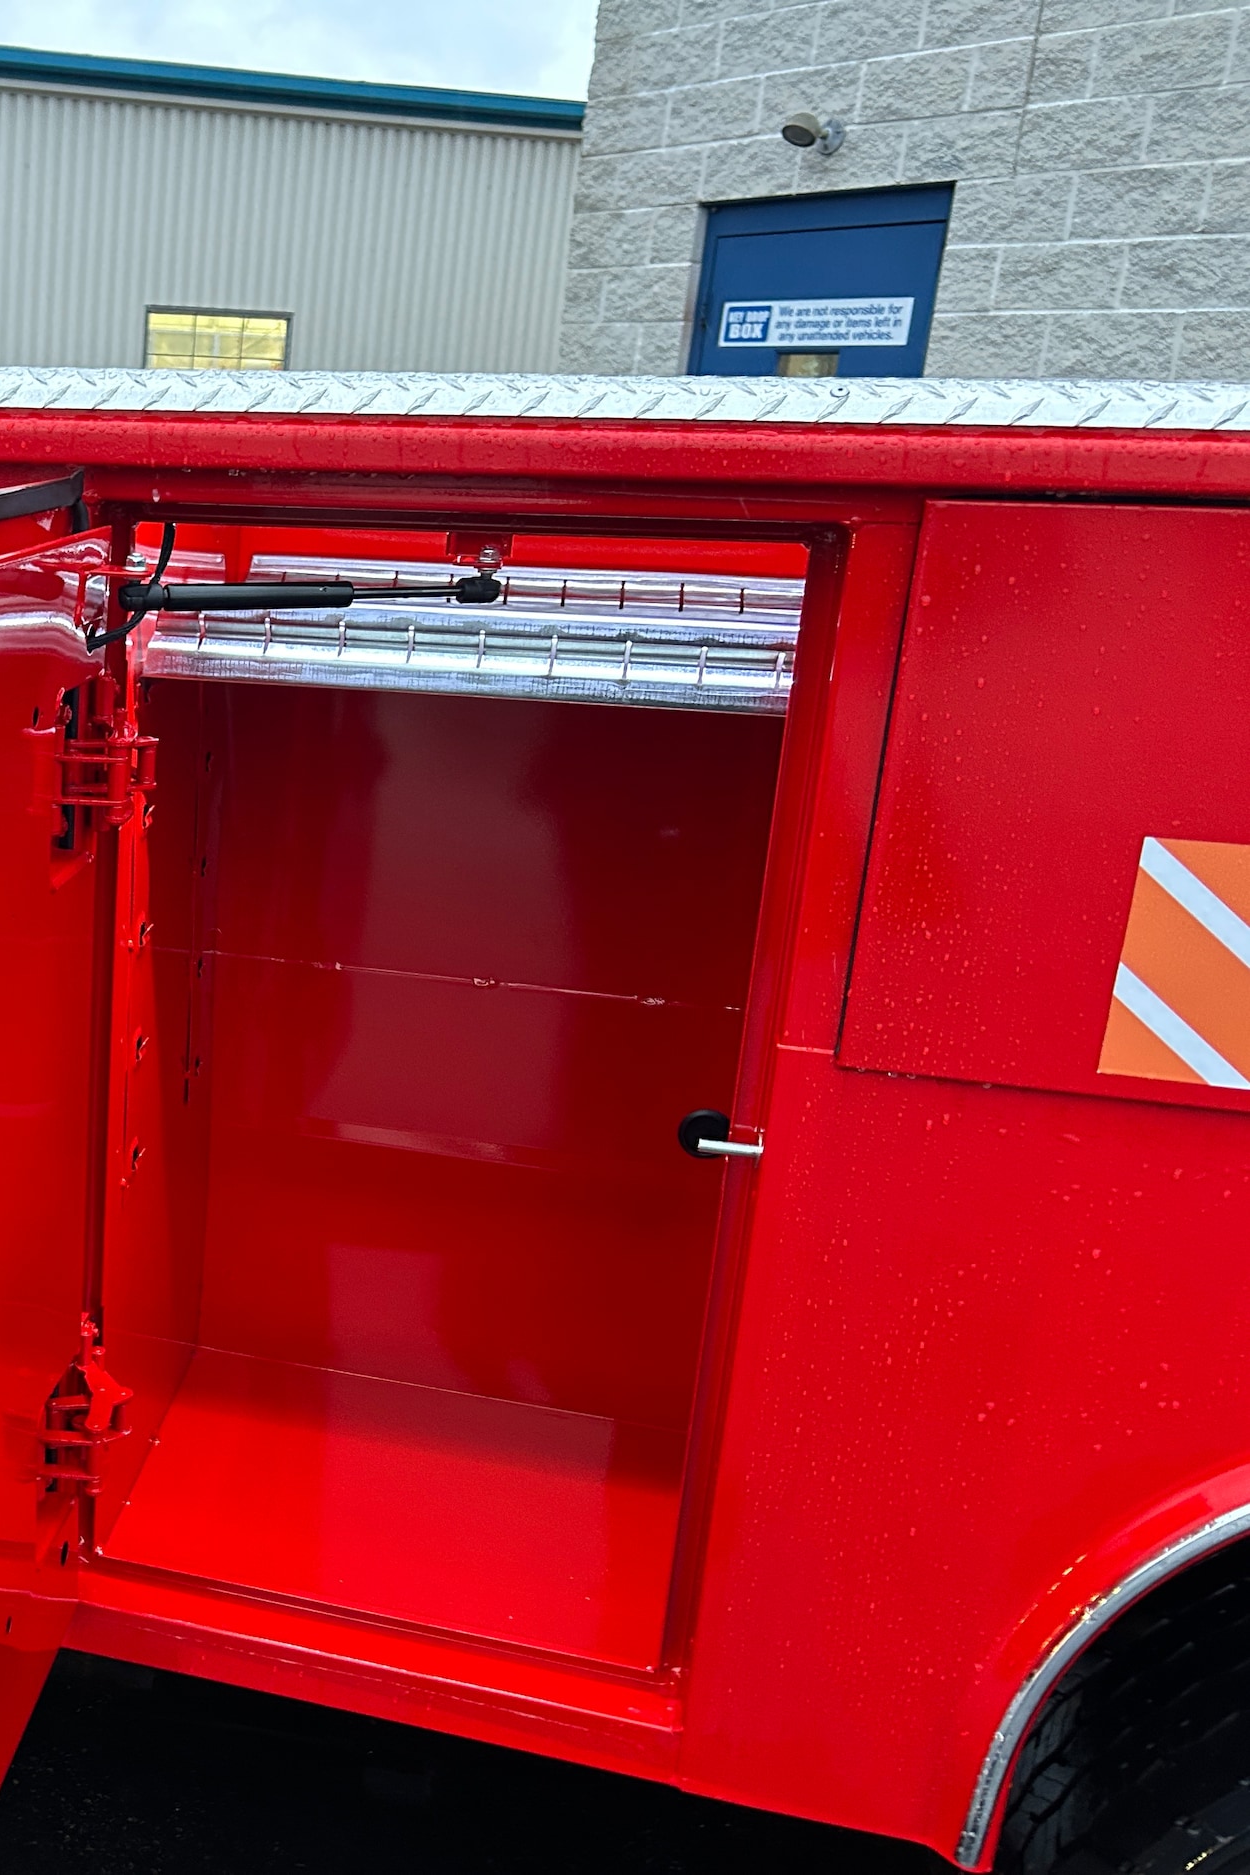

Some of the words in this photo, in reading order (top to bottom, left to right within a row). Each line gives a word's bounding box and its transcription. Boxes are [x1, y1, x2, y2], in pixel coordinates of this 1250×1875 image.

[779, 305, 794, 317] We
[795, 307, 811, 317] are
[812, 305, 829, 316] not
[830, 303, 886, 318] responsible
[888, 303, 904, 315] for
[729, 323, 764, 339] BOX
[775, 321, 791, 332] any
[793, 318, 830, 331] damage
[832, 320, 844, 329] or
[845, 317, 872, 328] items
[874, 316, 891, 328] left
[892, 316, 902, 327] in
[778, 333, 794, 343] any
[796, 330, 850, 341] unattended
